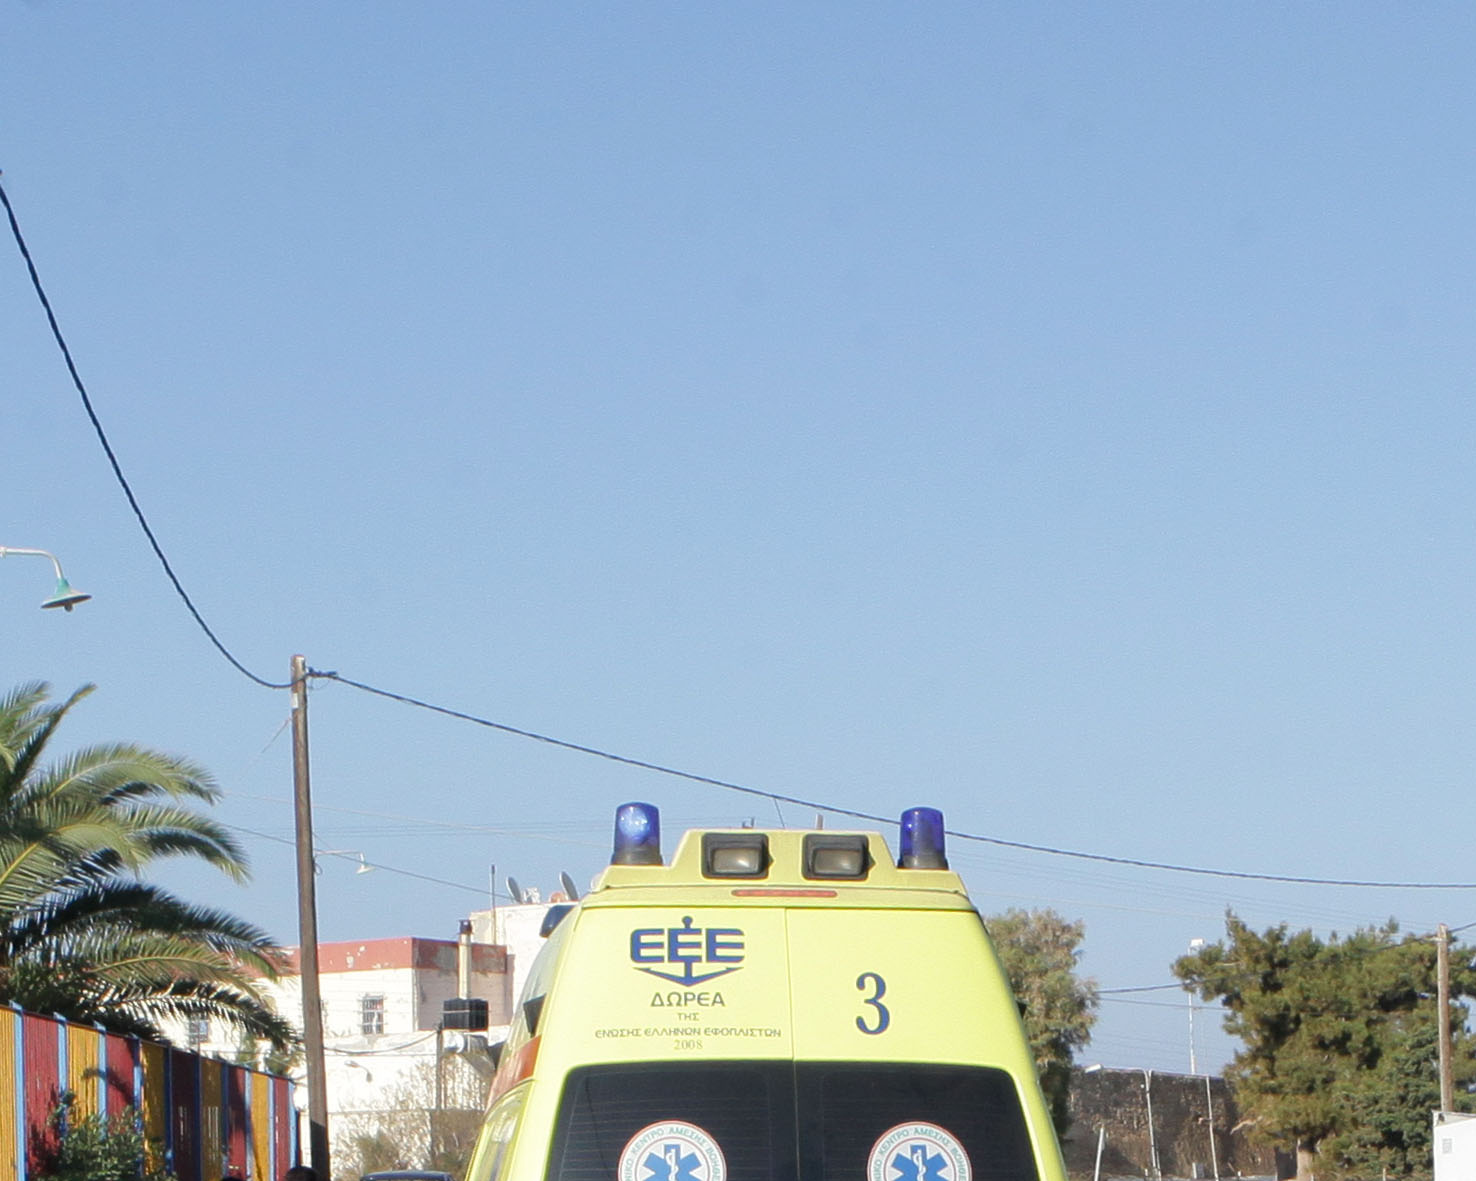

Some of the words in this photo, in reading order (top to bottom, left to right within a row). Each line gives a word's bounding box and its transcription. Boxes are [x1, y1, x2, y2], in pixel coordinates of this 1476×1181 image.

[630, 927, 745, 963] ΕΕΕ
[650, 991, 726, 1008] ΔΩΡΕΑ
[855, 971, 890, 1035] 3
[676, 1011, 700, 1022] ΤΗΣ
[594, 1028, 641, 1038] ΕΝΩΣΗΣ
[643, 1026, 701, 1038] ΕΛΛΗΝΩΝ
[703, 1027, 782, 1038] ΕΦΟΠΛΙΣΤΩΝ
[673, 1039, 704, 1050] 2008
